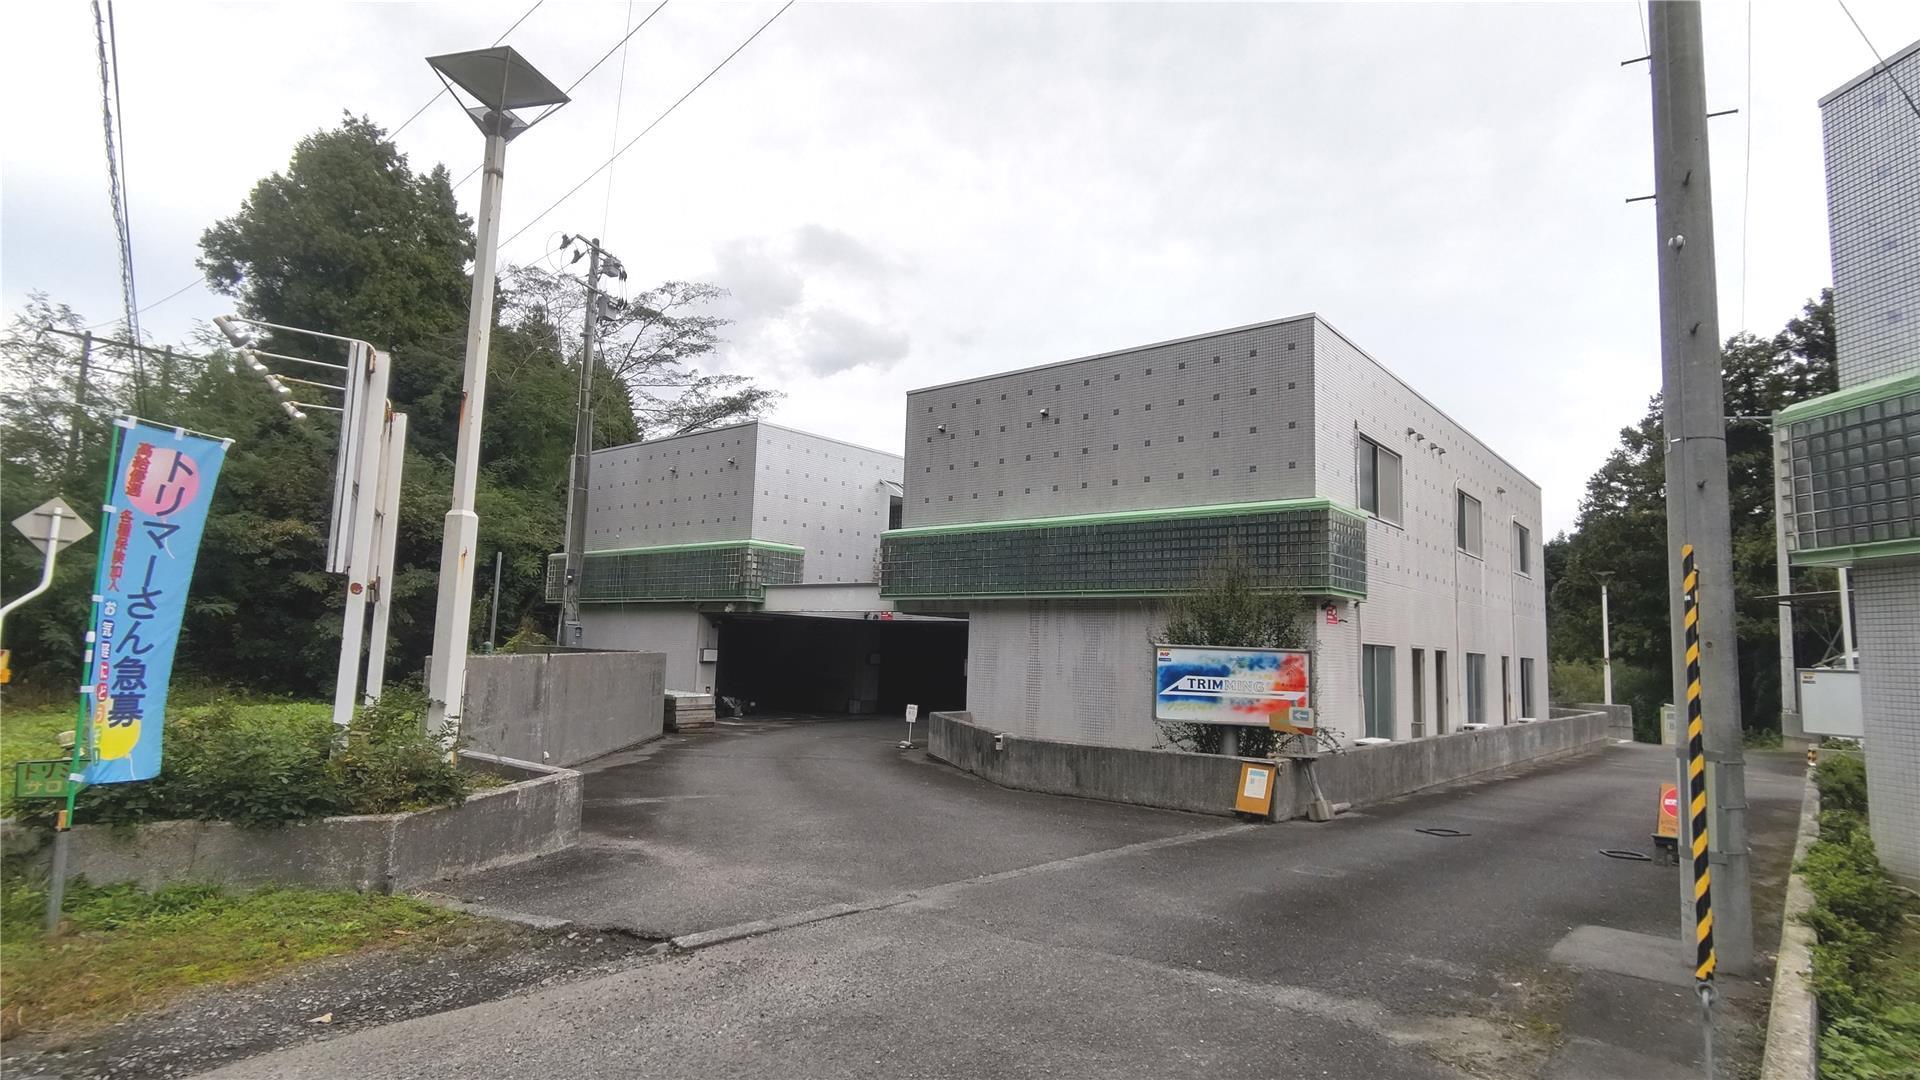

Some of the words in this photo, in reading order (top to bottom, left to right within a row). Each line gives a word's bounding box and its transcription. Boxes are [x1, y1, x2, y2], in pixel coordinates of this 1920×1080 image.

[107, 450, 194, 728] トリマーさん急募
[1186, 677, 1265, 693] TRIMMING
